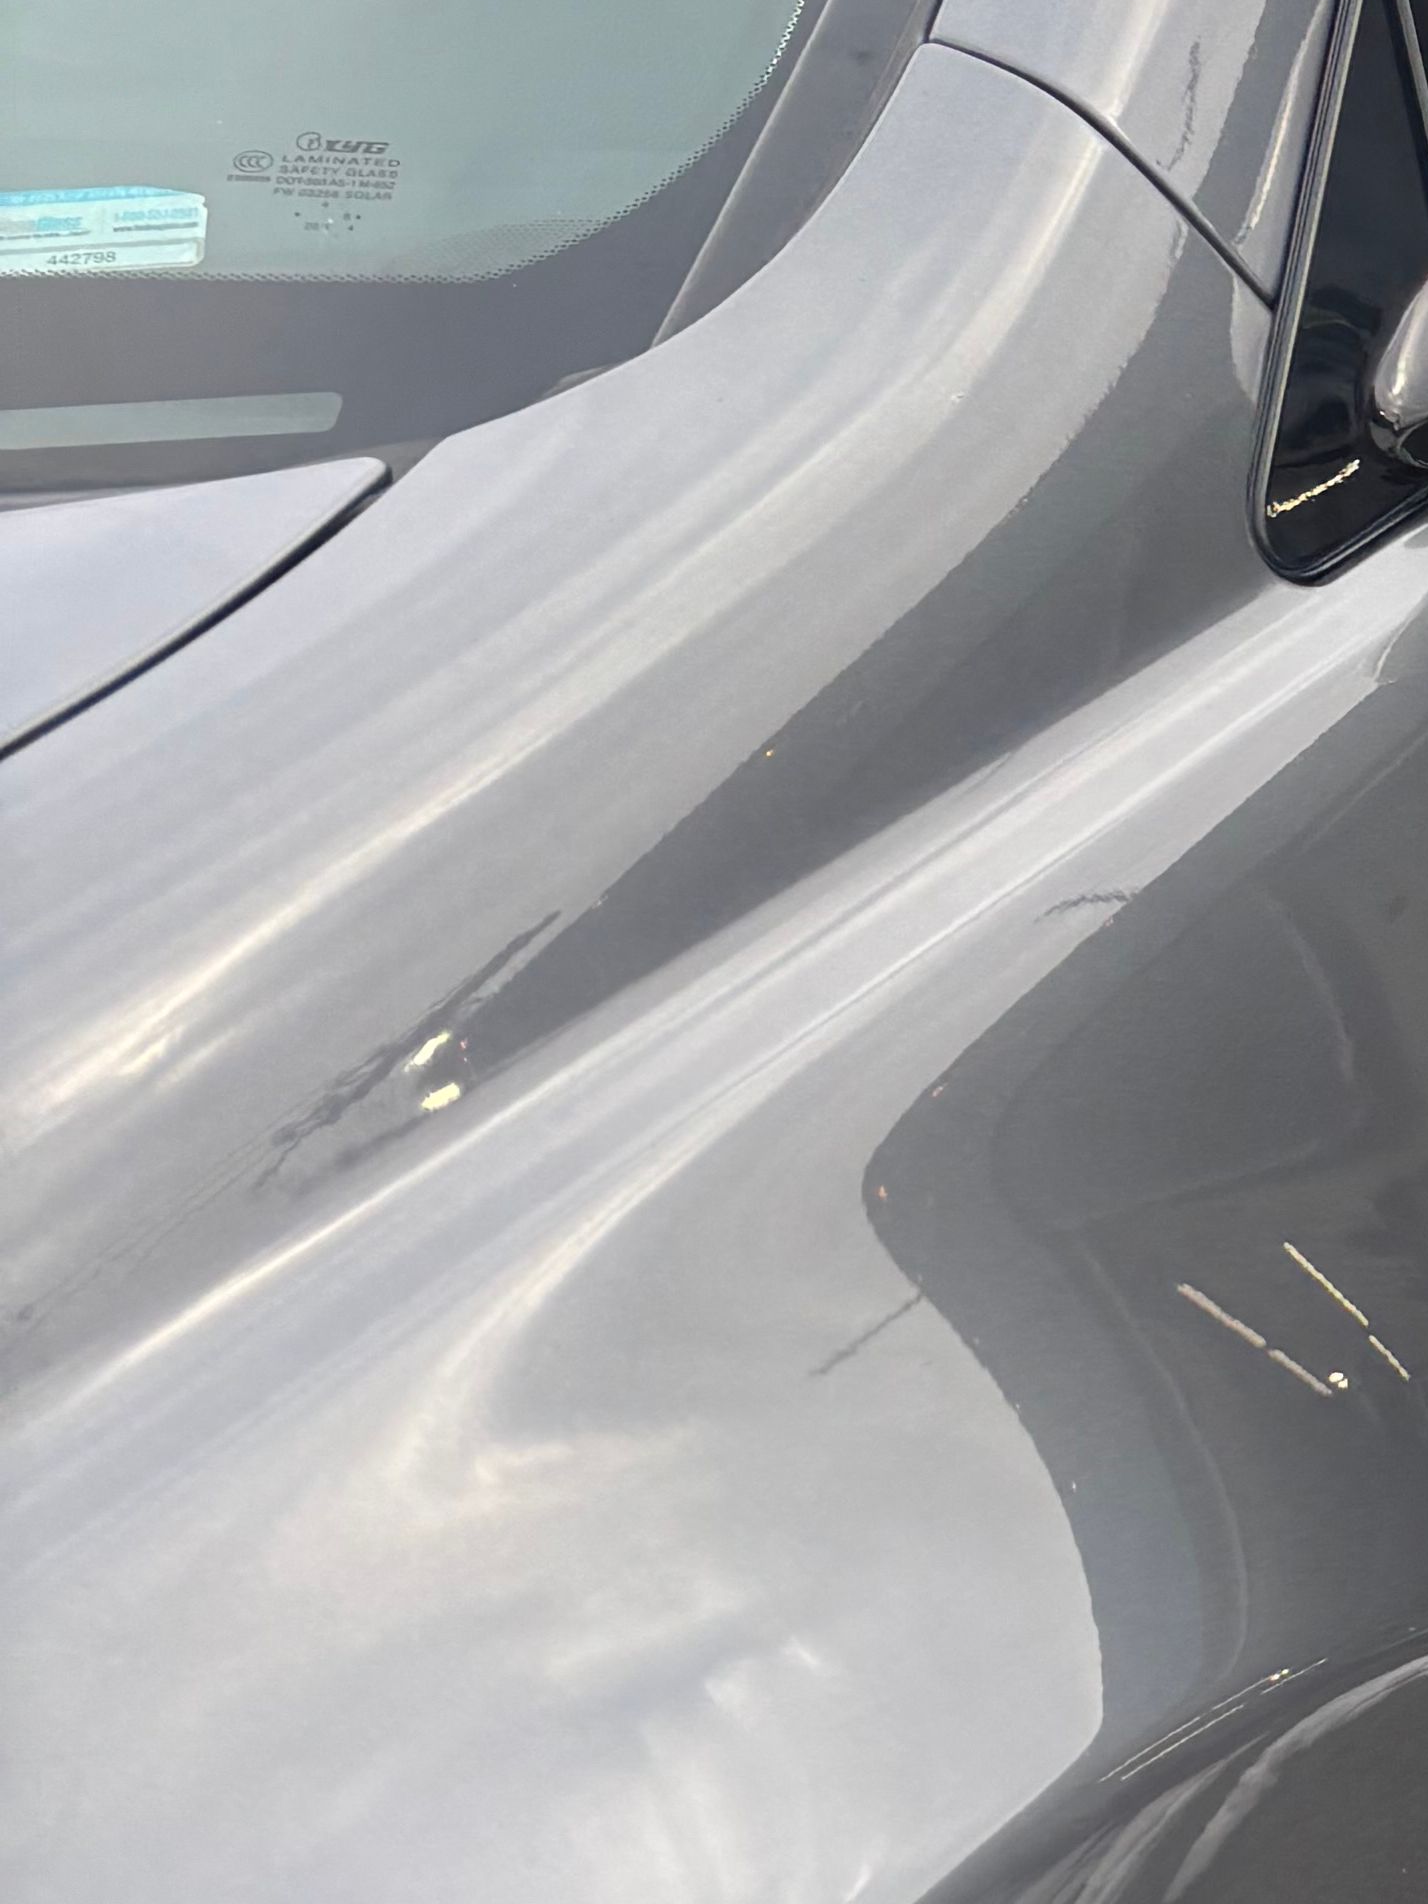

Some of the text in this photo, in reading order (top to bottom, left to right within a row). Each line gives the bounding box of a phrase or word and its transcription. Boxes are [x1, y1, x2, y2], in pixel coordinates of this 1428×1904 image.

[281, 155, 401, 168] LAMINATED
[279, 165, 398, 179] SAFETY GLASS
[345, 190, 393, 200] SOLAR
[46, 250, 117, 266] 442798
